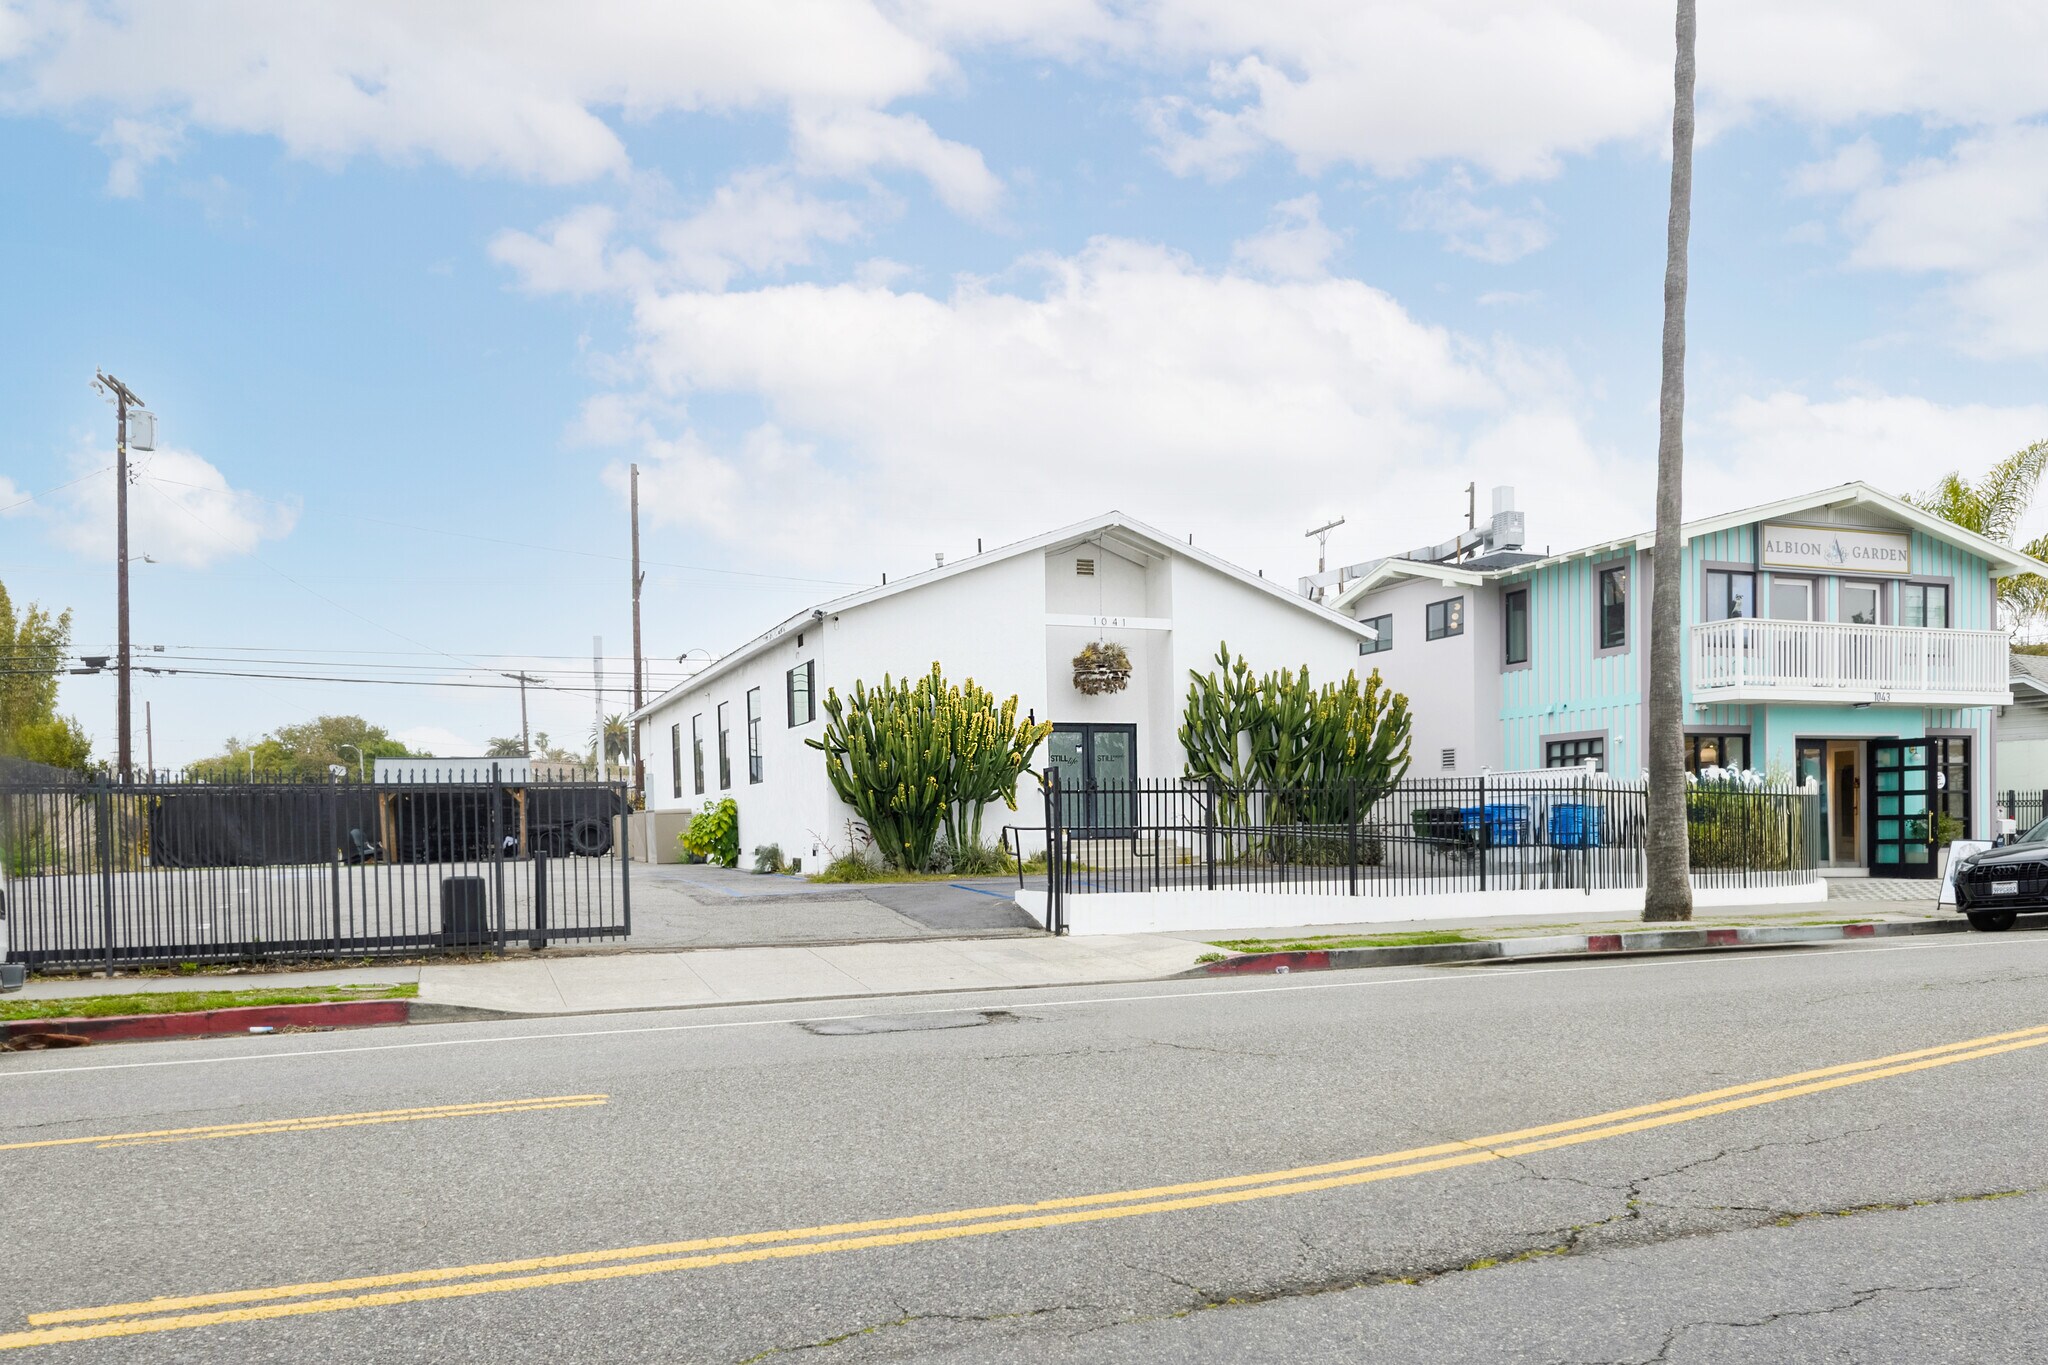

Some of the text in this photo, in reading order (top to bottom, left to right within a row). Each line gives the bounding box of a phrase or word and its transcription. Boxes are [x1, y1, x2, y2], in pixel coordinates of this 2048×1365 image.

[1765, 539, 1821, 556] ALBION
[1852, 546, 1908, 562] GARDEN
[1093, 616, 1126, 627] 1041
[1874, 691, 1891, 702] 1043
[1050, 754, 1068, 763] STILL
[1096, 754, 1115, 762] STILL
